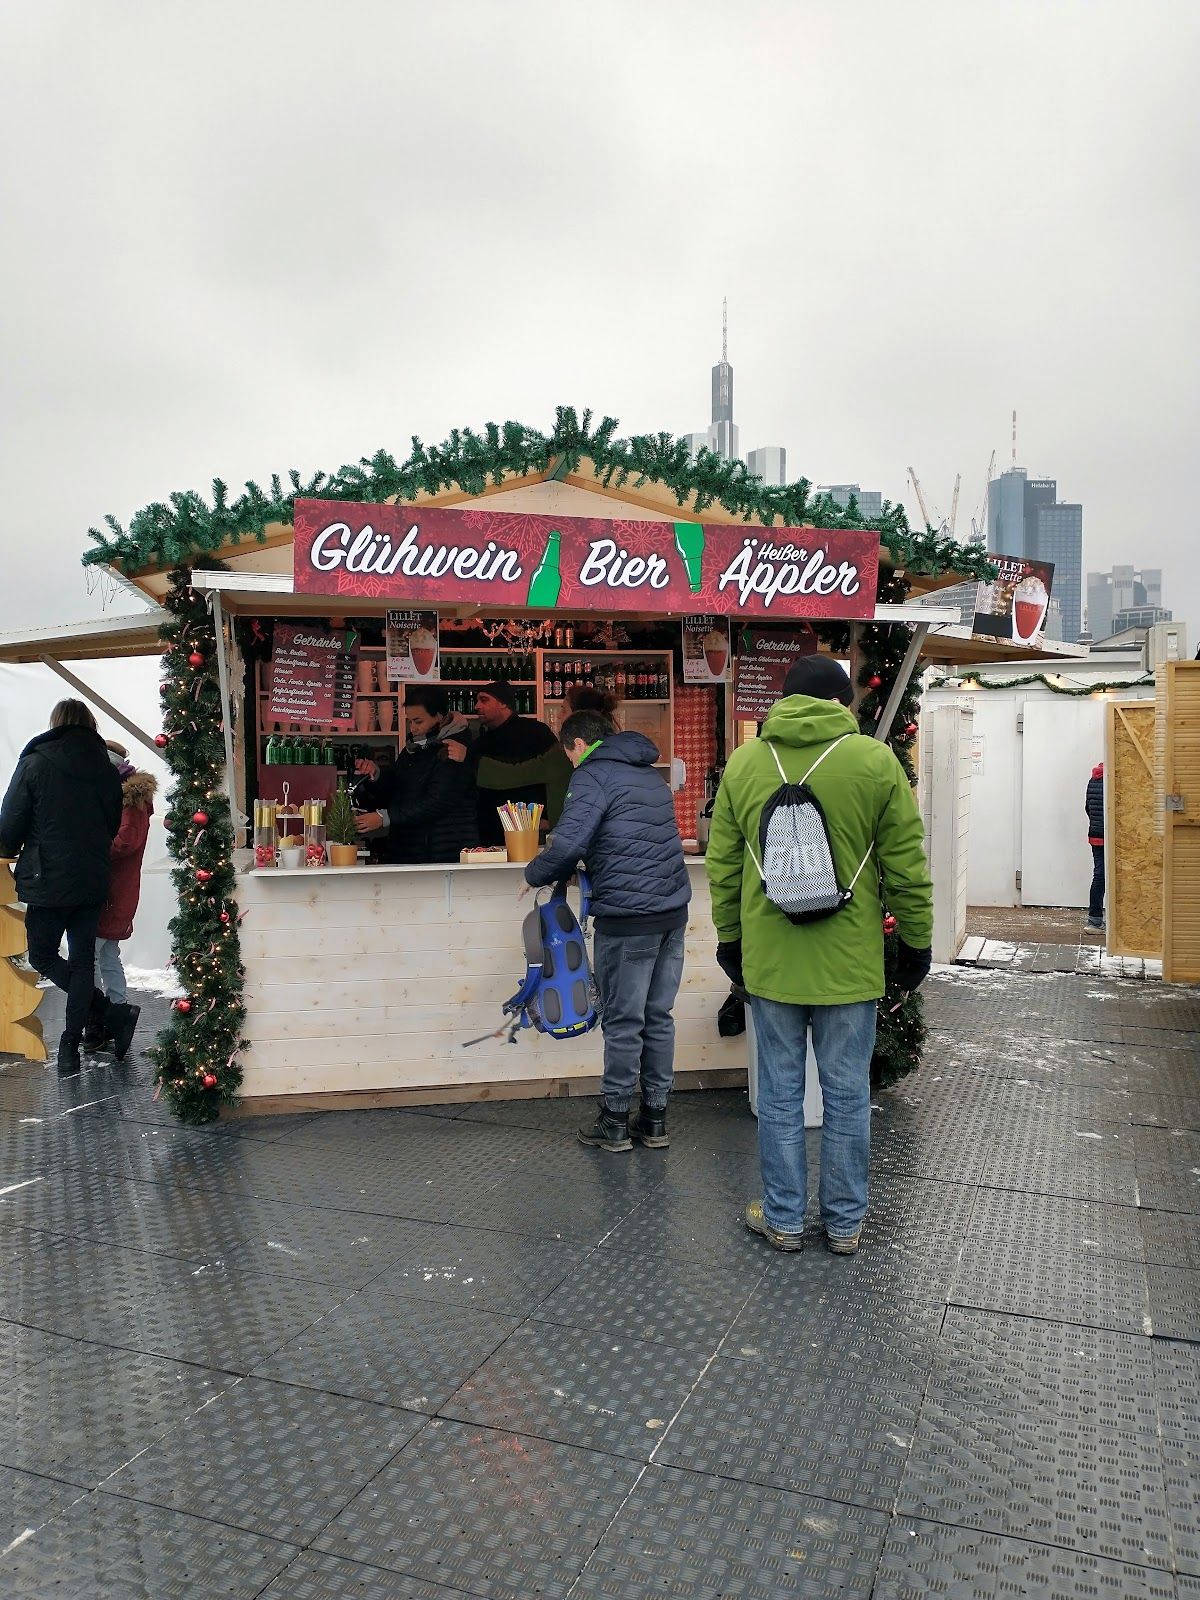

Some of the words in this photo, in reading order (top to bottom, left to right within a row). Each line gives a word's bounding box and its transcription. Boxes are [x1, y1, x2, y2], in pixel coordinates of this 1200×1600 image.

[309, 522, 522, 583] Glühwein
[757, 543, 808, 562] Heißer
[579, 538, 670, 588] Bier
[718, 539, 860, 606] Äppler
[389, 612, 423, 621] LILLET
[685, 616, 715, 625] LILLET
[389, 621, 421, 630] Noisette
[685, 624, 714, 633] Noisette
[293, 633, 342, 650] Getränke
[756, 638, 801, 651] Getränke
